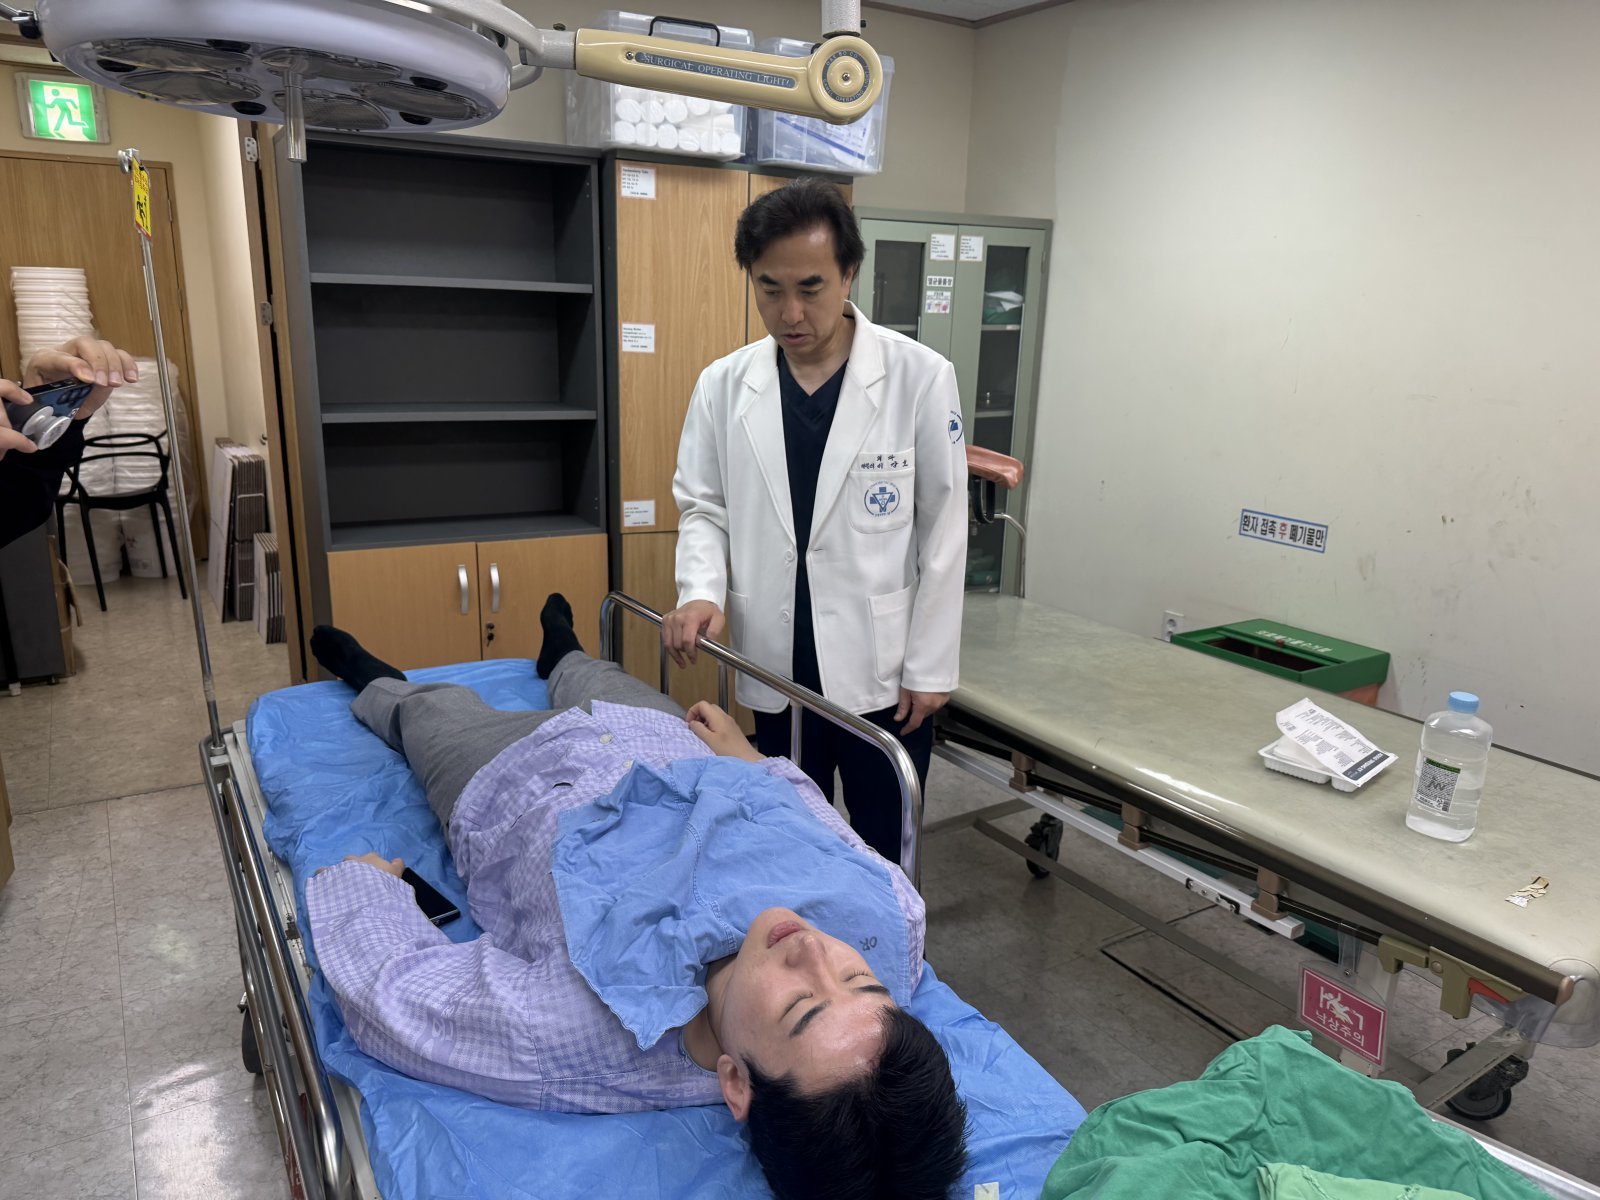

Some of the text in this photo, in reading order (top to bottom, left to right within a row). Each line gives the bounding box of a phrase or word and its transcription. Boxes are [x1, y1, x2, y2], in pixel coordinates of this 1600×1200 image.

[643, 53, 694, 71] SURGICAL
[697, 64, 753, 81] OPERATING
[1242, 514, 1325, 548] 환자 접촉 후 폐기물만
[1315, 1009, 1365, 1047] 낙상주의
